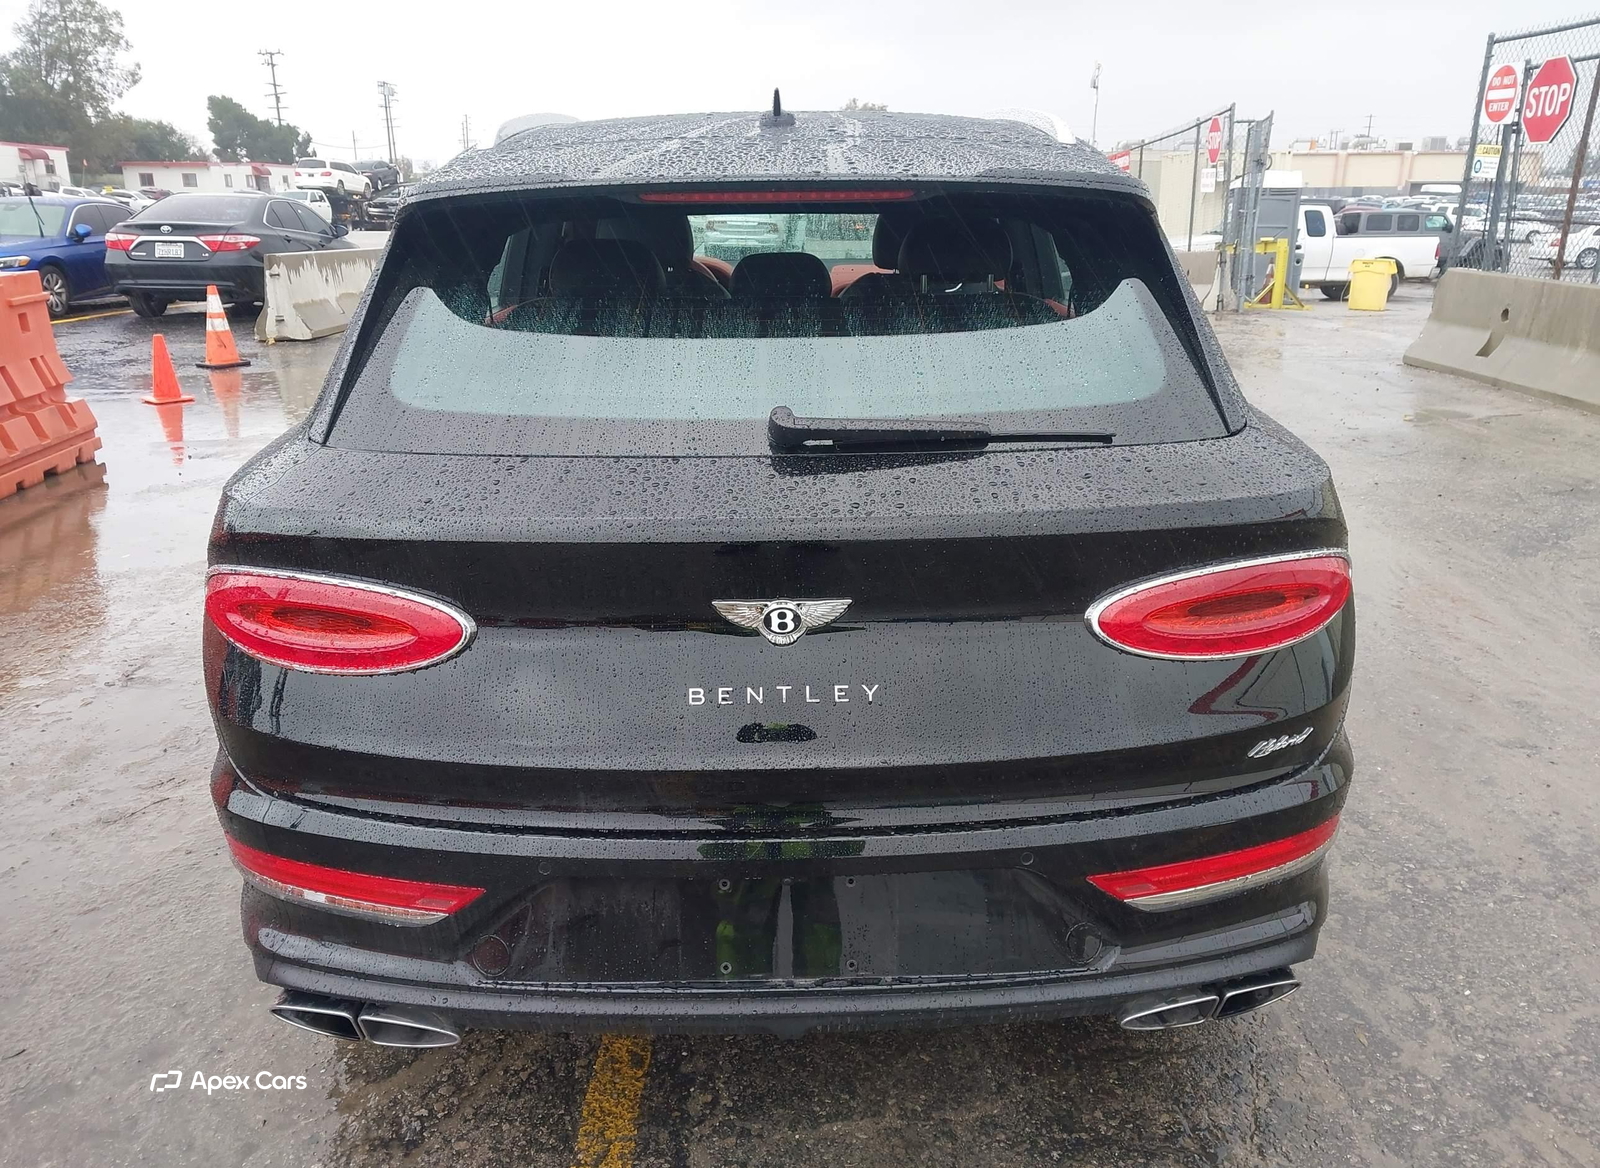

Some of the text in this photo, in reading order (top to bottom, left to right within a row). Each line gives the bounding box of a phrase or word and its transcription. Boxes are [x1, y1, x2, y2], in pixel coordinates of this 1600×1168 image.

[1491, 75, 1515, 86] DO NOT
[1488, 102, 1509, 112] ENTER
[1525, 82, 1571, 119] STOP
[1208, 131, 1221, 150] STOP
[1482, 147, 1500, 155] CAUTION
[769, 609, 796, 633] B
[688, 684, 879, 705] BENTLEY
